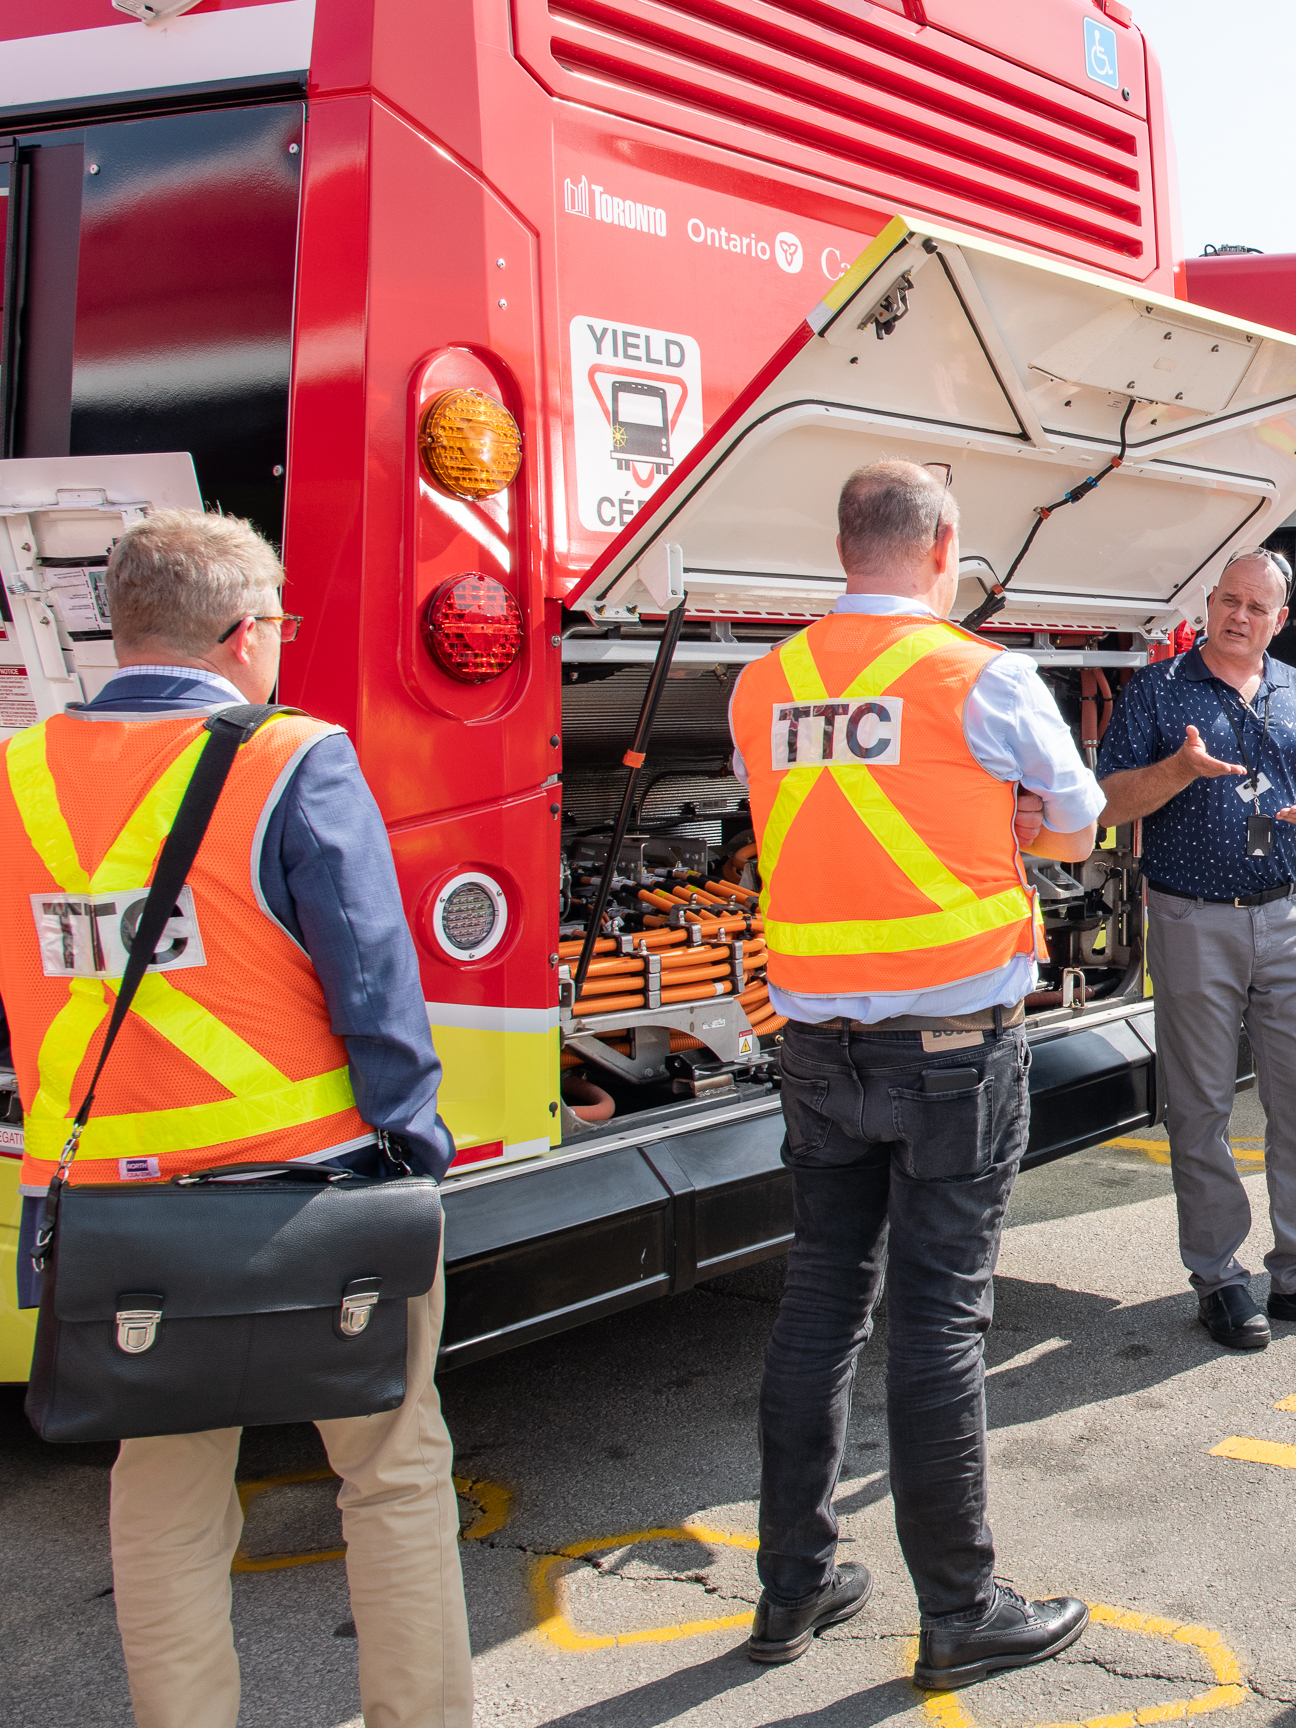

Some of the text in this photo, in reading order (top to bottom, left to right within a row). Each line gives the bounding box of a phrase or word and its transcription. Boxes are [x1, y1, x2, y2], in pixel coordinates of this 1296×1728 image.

[591, 184, 667, 237] TORONTO
[687, 218, 771, 261] Ontario
[587, 324, 686, 368] YIELD
[597, 490, 648, 527] CÉ
[779, 702, 892, 762] TTC
[41, 896, 189, 972] TTC
